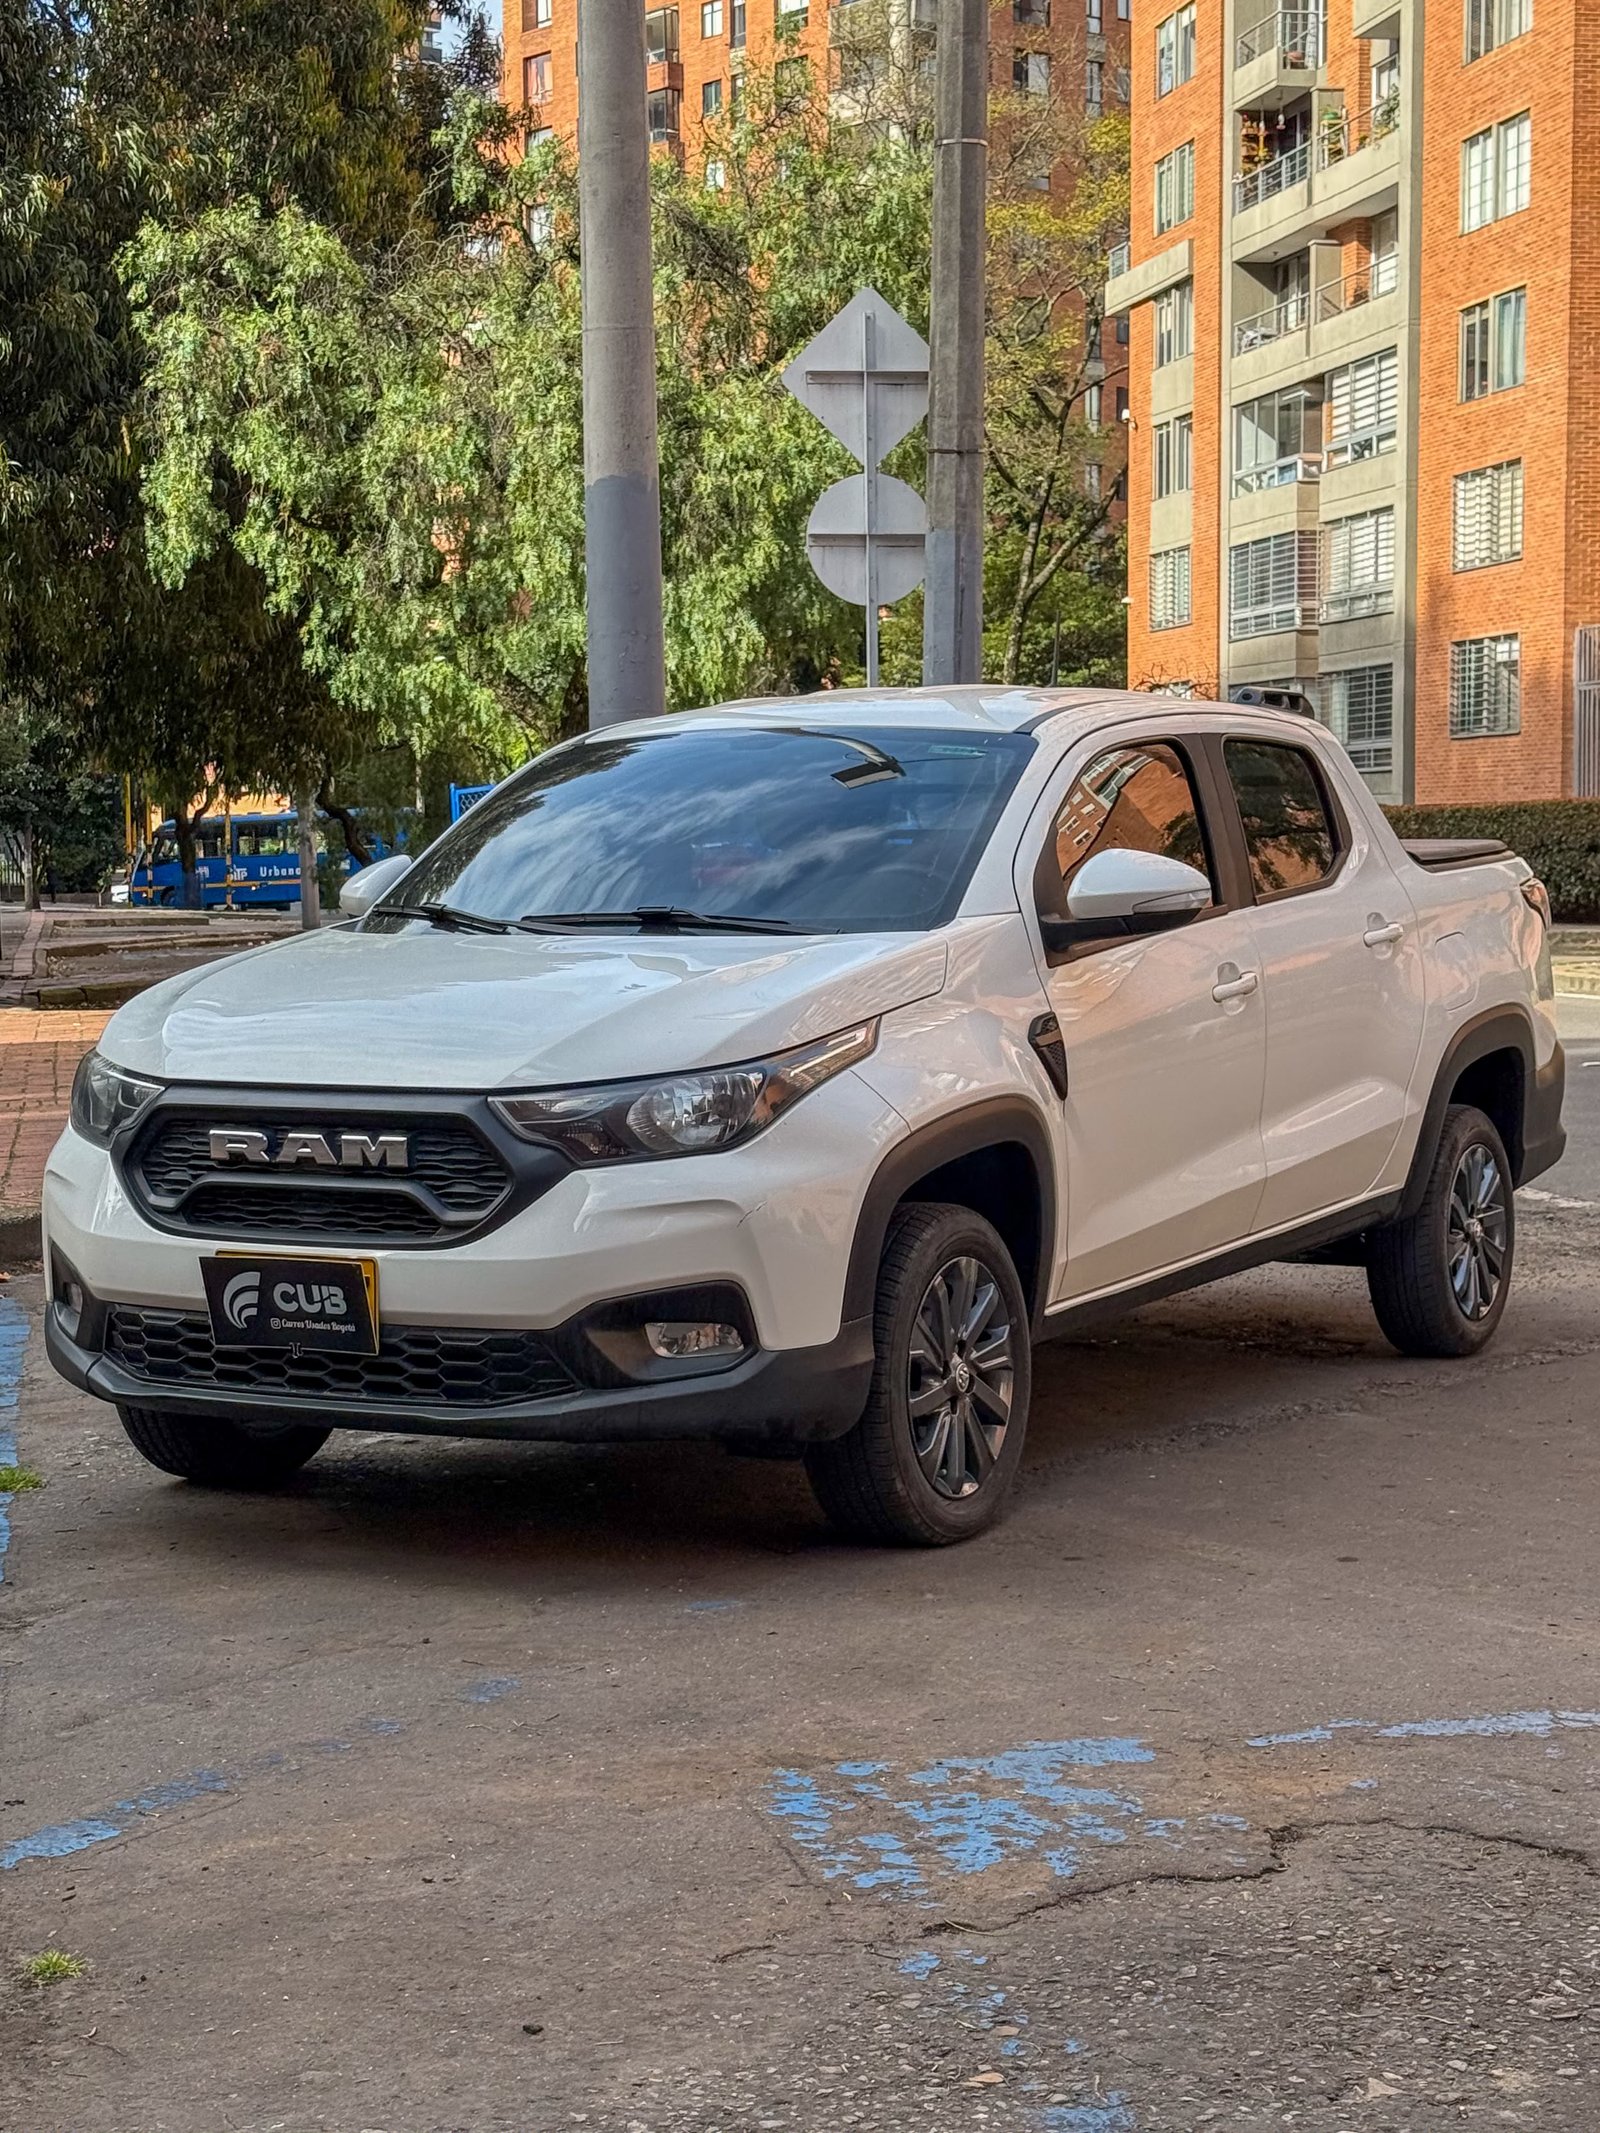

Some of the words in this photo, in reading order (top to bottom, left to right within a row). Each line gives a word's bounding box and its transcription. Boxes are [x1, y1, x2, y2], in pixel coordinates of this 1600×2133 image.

[260, 865, 301, 877] Urbano
[209, 1129, 409, 1168] RAM
[273, 1282, 348, 1315] CUB
[282, 1318, 304, 1329] Carros
[305, 1320, 331, 1330] Usados
